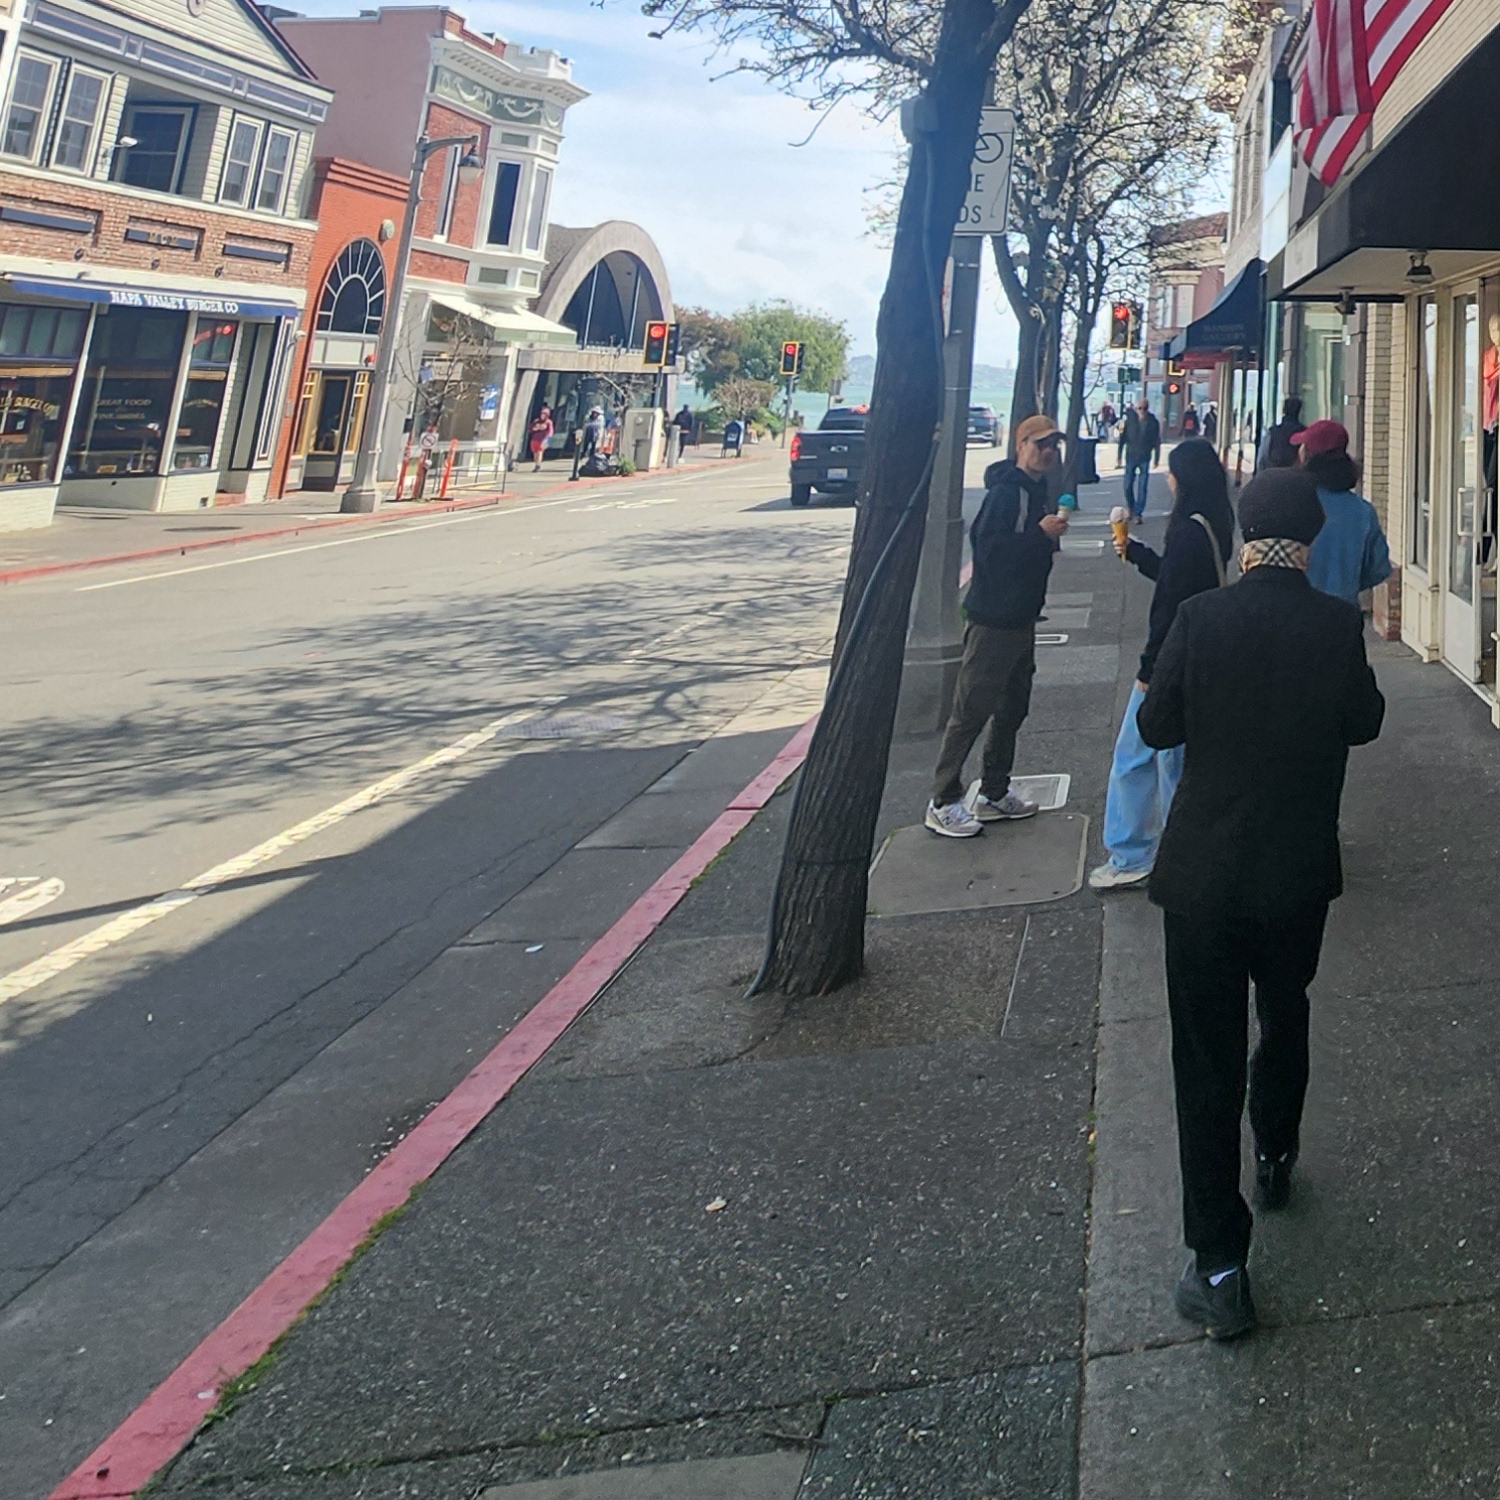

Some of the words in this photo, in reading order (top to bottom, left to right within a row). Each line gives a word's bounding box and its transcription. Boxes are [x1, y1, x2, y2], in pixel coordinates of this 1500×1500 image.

[110, 290, 142, 306] NAPA
[144, 295, 185, 310] VALLEY
[186, 299, 224, 313] BURGER
[224, 302, 239, 314] CO
